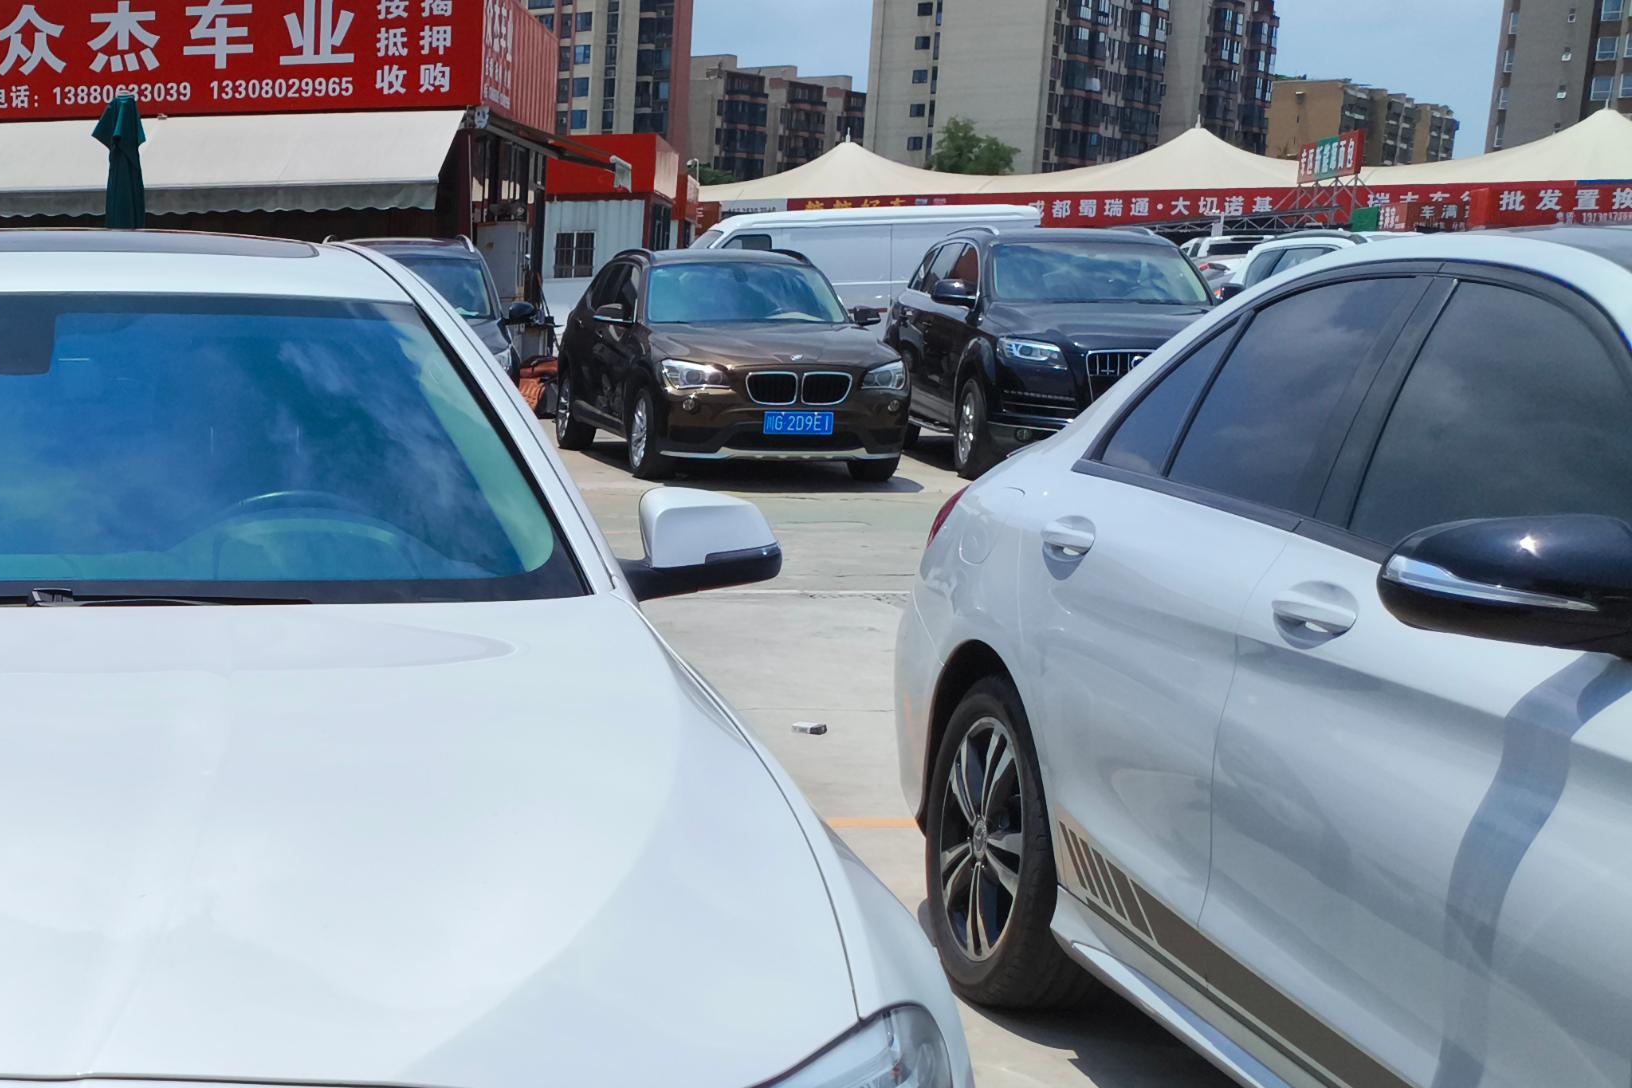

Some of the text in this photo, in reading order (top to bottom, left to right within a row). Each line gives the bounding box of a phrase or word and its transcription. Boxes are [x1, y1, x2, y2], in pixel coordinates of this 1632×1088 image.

[376, 25, 452, 57] 抵押
[210, 77, 353, 100] 13308029965
[375, 63, 451, 94] 收购
[1499, 188, 1632, 211] 批发置换
